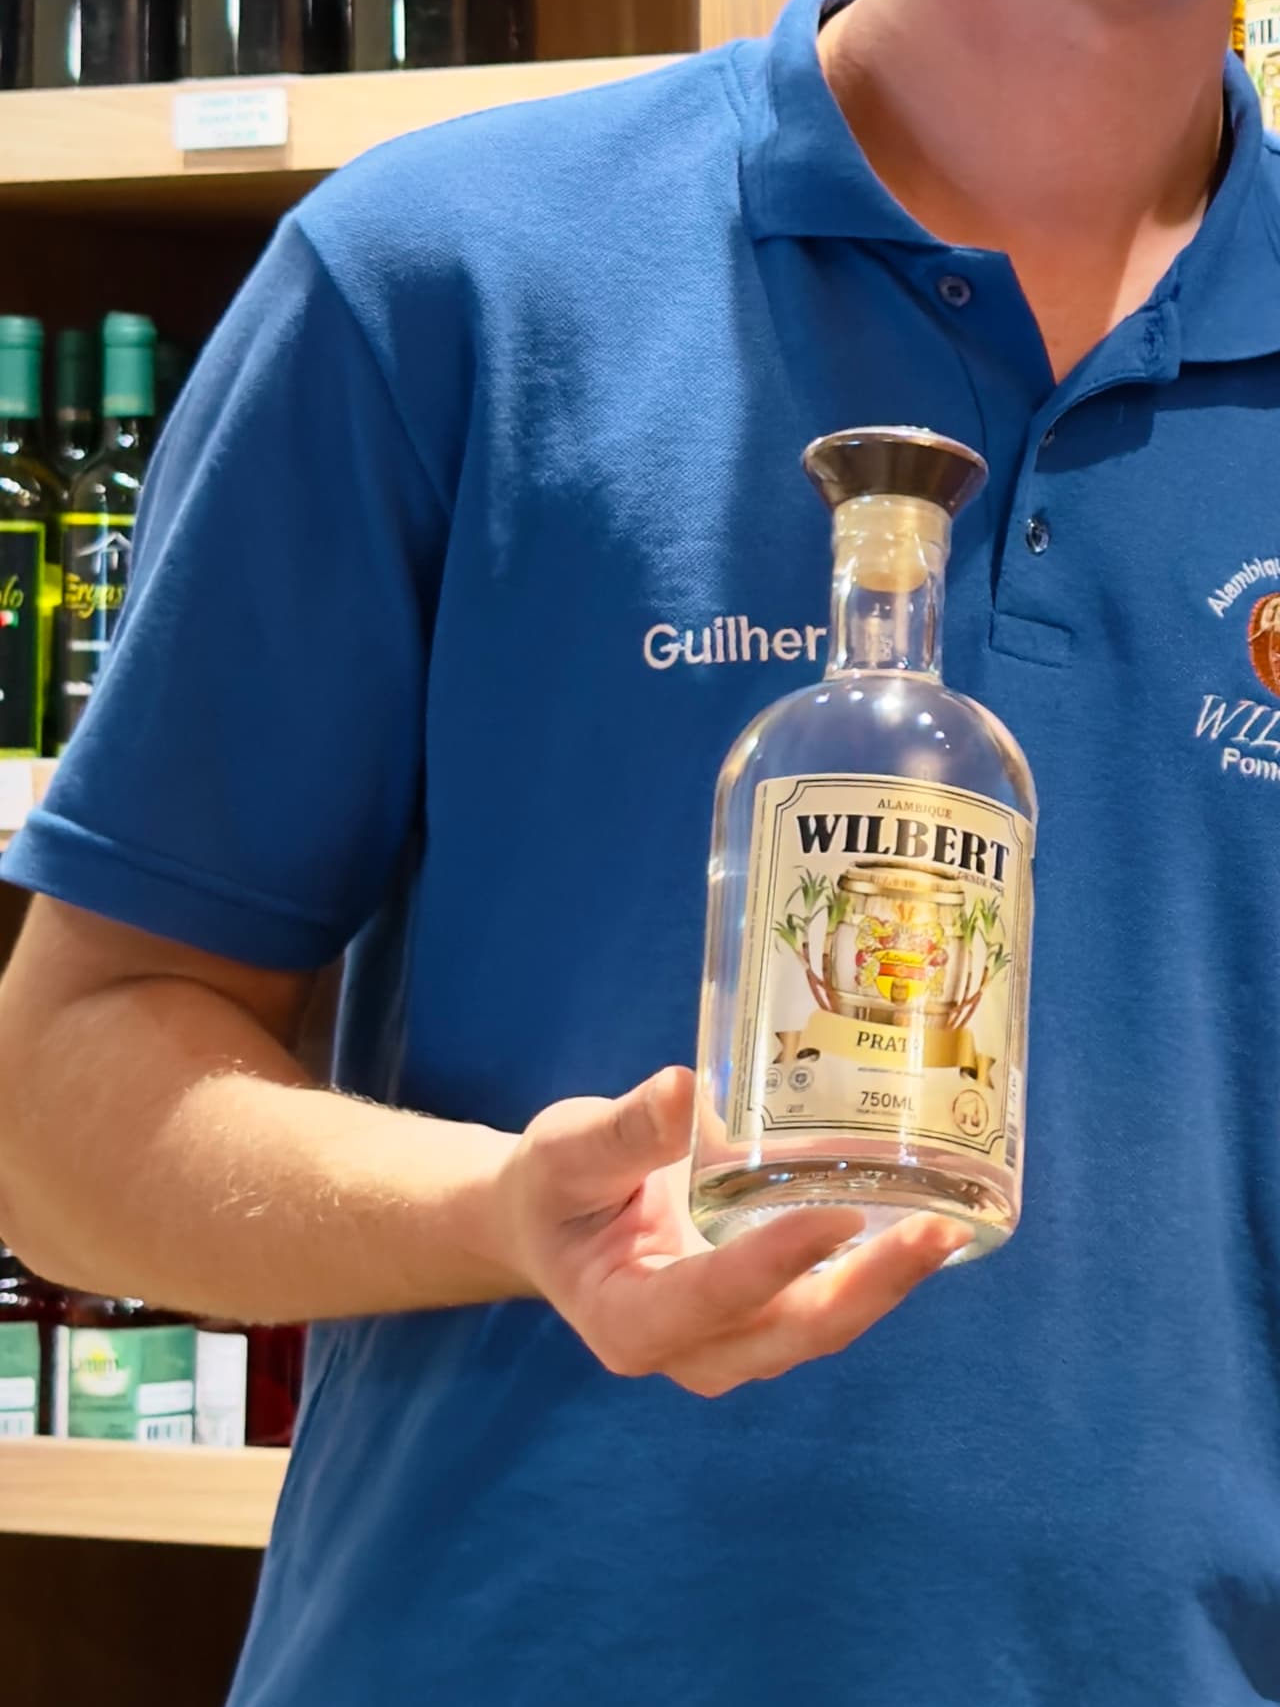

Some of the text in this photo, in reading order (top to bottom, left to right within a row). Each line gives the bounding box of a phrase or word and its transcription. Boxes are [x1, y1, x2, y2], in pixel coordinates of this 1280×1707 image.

[643, 616, 828, 670] Guilher
[877, 797, 952, 819] ALAMBIQUE
[796, 813, 1010, 883] WILBERT
[860, 1091, 915, 1111] 750ML
